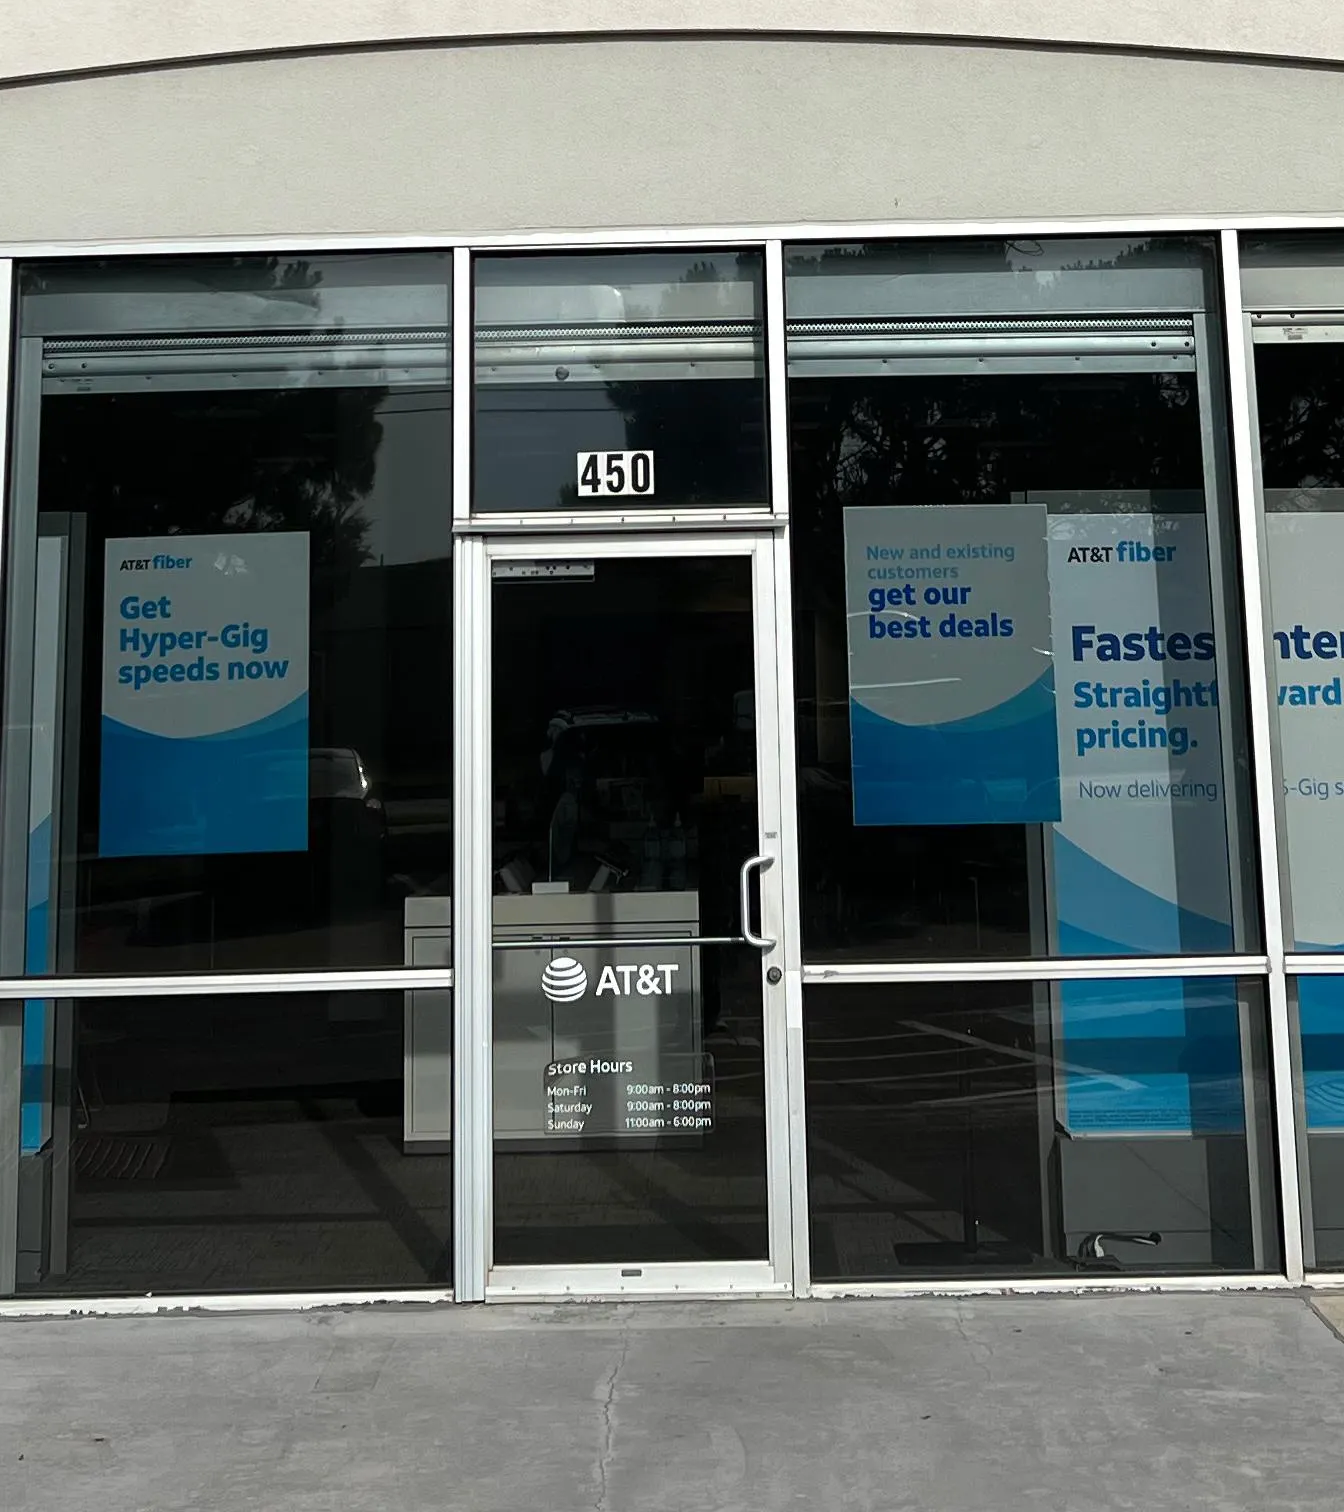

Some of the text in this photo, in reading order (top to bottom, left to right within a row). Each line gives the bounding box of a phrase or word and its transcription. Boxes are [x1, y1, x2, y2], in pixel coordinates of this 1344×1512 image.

[580, 452, 651, 493] 450
[120, 555, 193, 571] AT&T fiber
[867, 543, 1015, 562] New and existing
[1067, 541, 1176, 563] AT&T fiber
[867, 565, 959, 580] customers
[120, 596, 171, 619] Get
[868, 584, 971, 612] get our
[869, 612, 1014, 638] best deals
[120, 622, 268, 658] Hyper-Gig
[118, 656, 289, 691] speeds now
[1076, 720, 1198, 757] pricing.
[1079, 781, 1121, 799] Now
[1127, 780, 1217, 801] delivering
[595, 963, 679, 996] AT&T
[548, 1059, 633, 1076] Store Hours
[547, 1085, 587, 1097] Mon-Fri
[626, 1084, 664, 1095] 9:00am
[672, 1083, 710, 1095] 8:00pm
[547, 1102, 592, 1115] Saturday
[626, 1101, 664, 1111] 9:00am
[673, 1100, 711, 1112] 8:00pm
[547, 1119, 584, 1131] Sunday
[625, 1118, 664, 1128] 11:00am
[673, 1116, 711, 1129] 6:00pm
